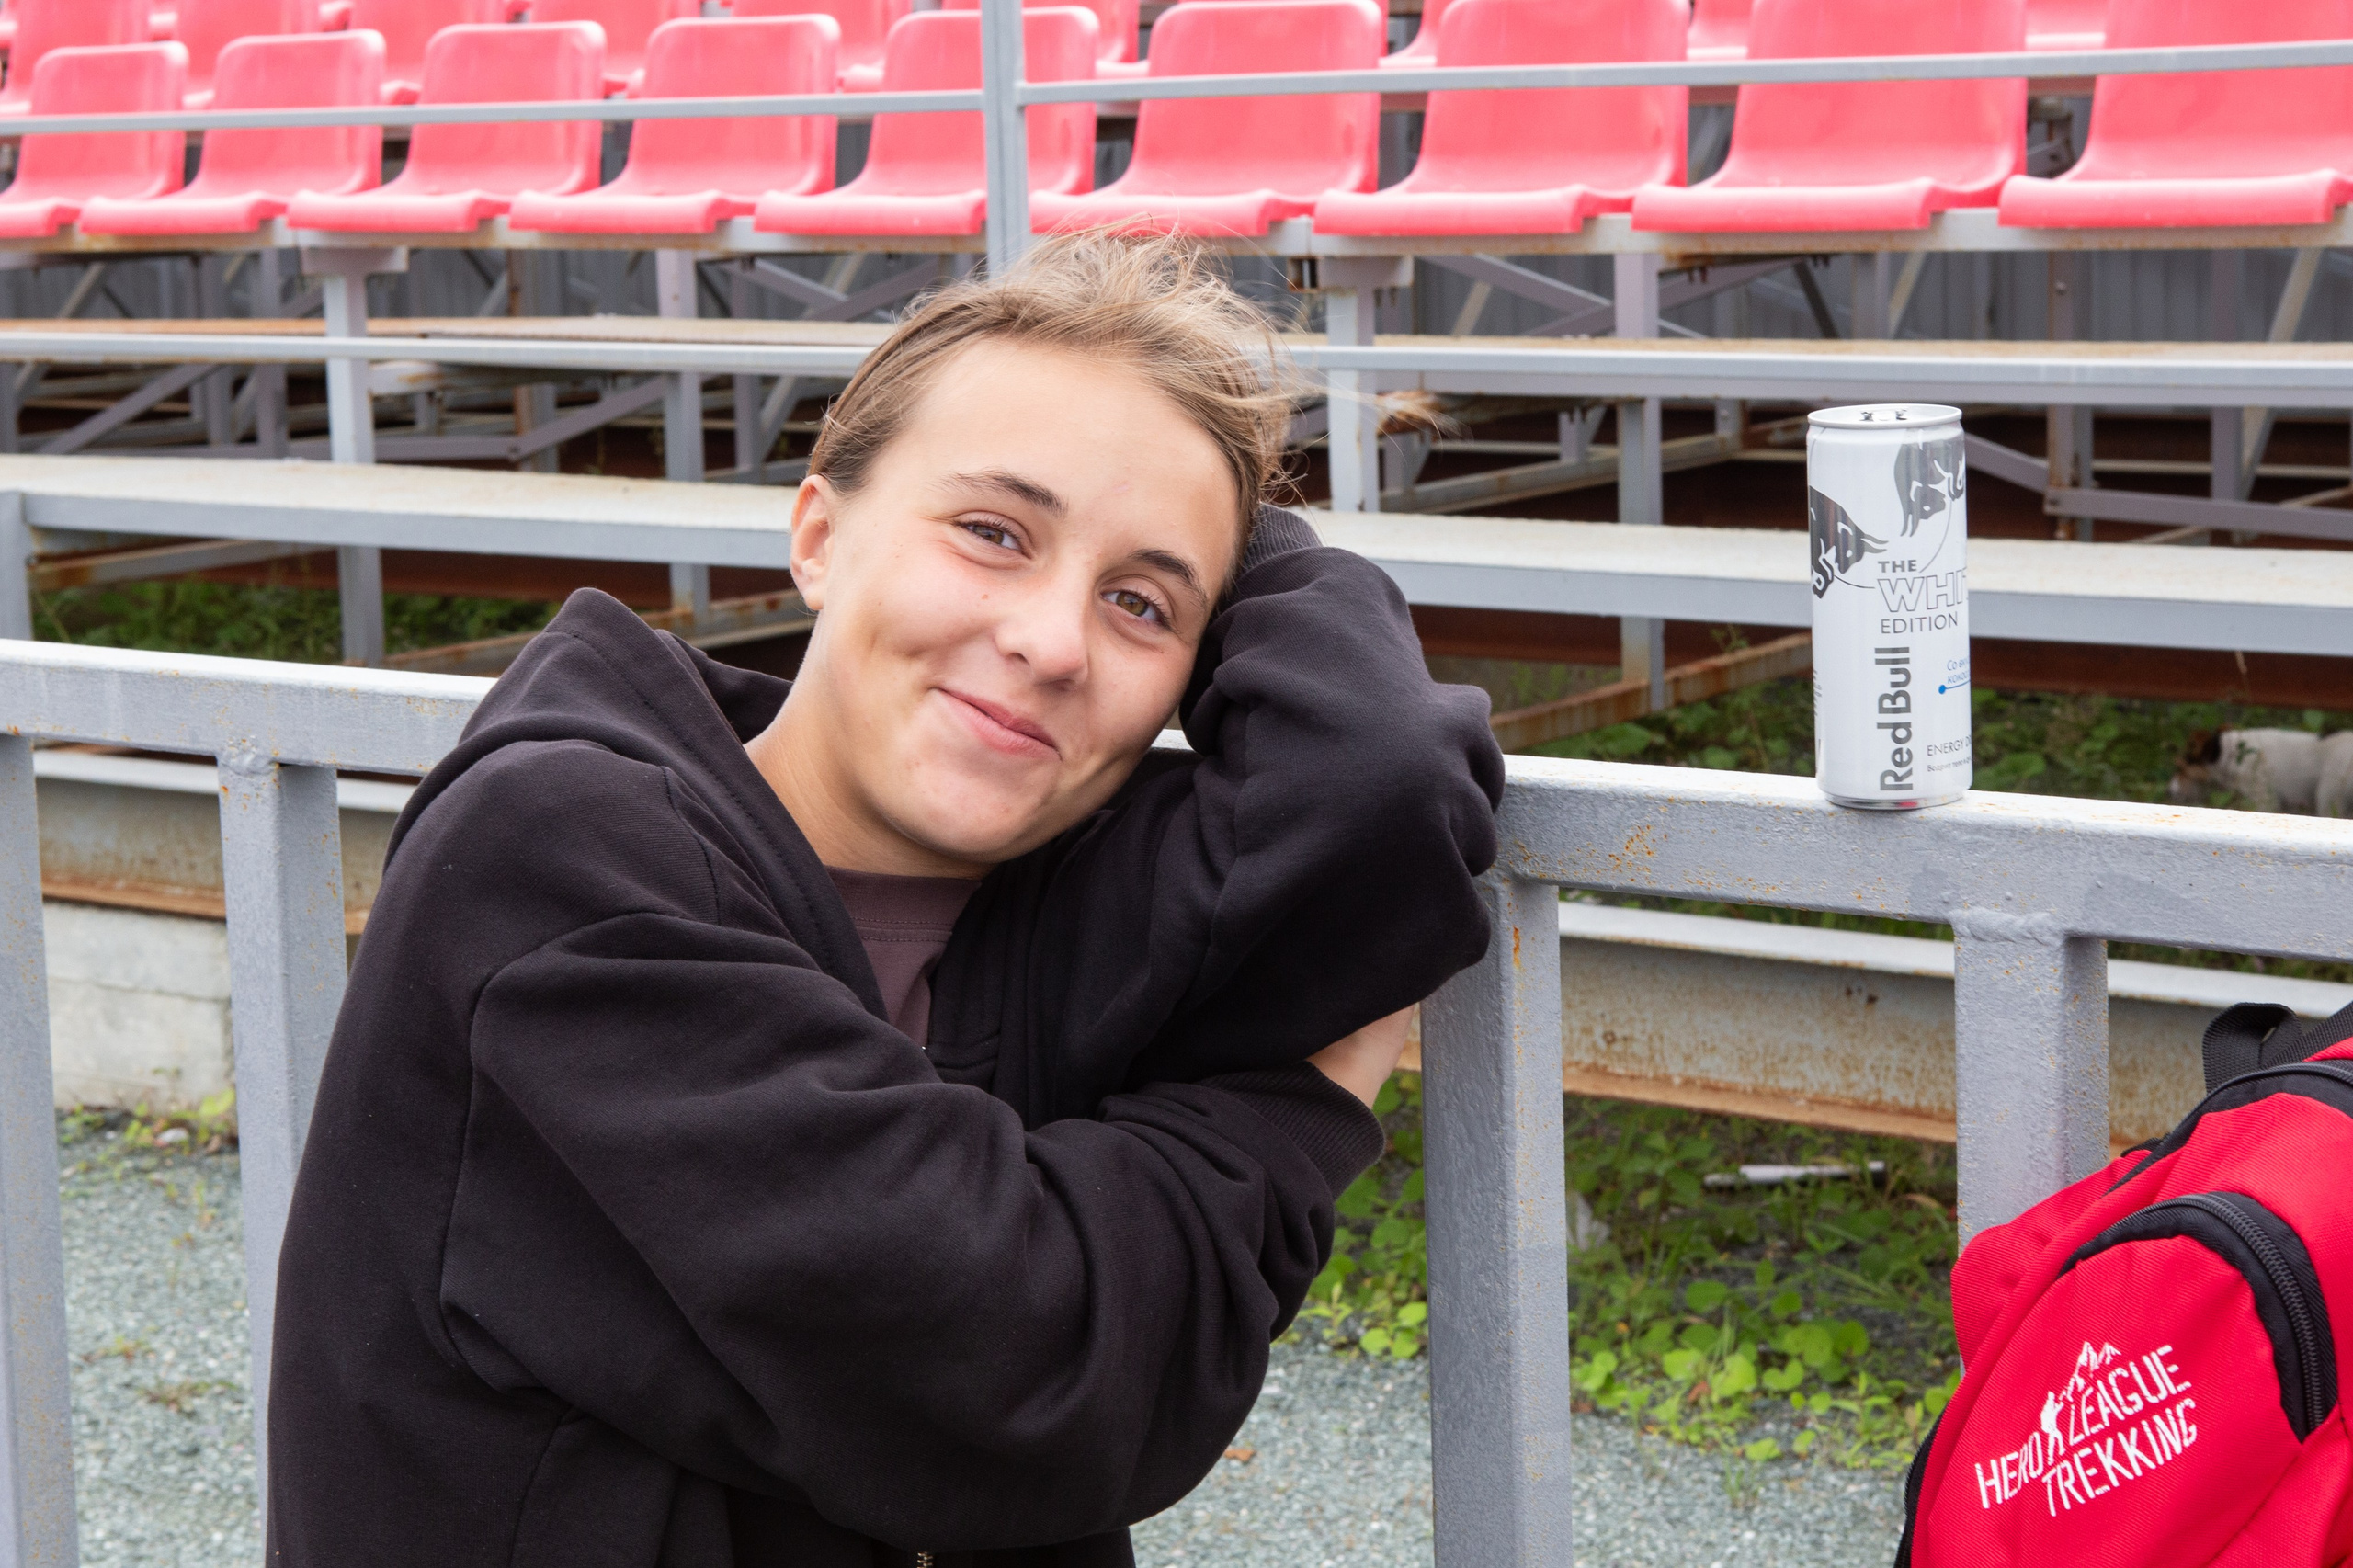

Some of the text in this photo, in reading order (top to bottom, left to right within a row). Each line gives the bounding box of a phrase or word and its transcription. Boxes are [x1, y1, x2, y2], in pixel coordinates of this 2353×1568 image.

[1877, 559, 1917, 574] THE
[1881, 611, 1958, 634] EDITION
[1874, 646, 1914, 791] Red Bull
[1927, 738, 1964, 756] ENERGY
[1974, 1344, 2192, 1509] HERO LEAGUE
[2041, 1397, 2198, 1517] TREKKING
